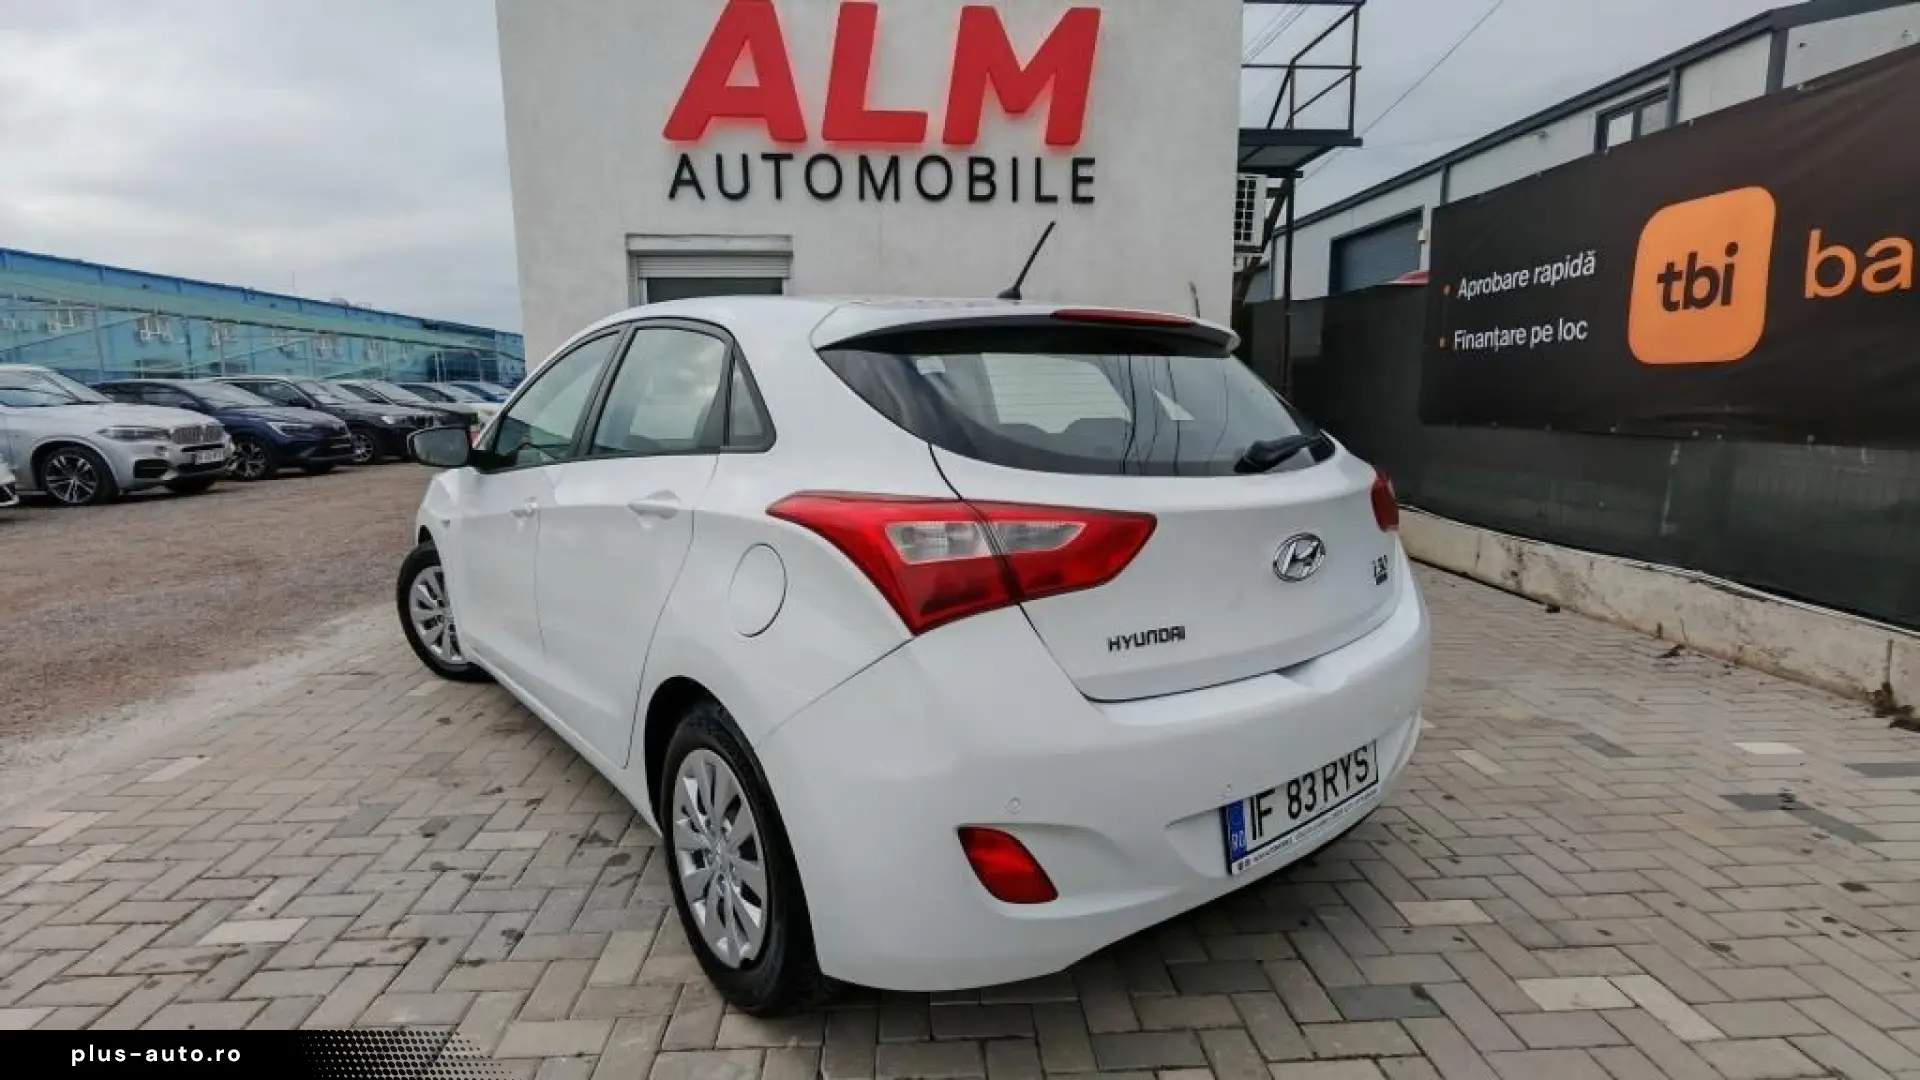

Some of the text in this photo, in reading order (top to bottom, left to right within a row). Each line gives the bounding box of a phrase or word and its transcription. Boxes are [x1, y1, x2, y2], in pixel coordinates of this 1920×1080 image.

[662, 0, 1101, 146] ALM
[668, 153, 1096, 204] AUTOMOBILE
[1457, 249, 1596, 300] Aprobare rapidă
[1657, 228, 1913, 312] tbi ba
[1530, 323, 1554, 349] pe
[1557, 317, 1589, 342] loc
[1107, 625, 1186, 652] HYUNDAI
[1250, 788, 1276, 841] IF
[1287, 772, 1317, 820] 83
[1321, 745, 1369, 803] RYS
